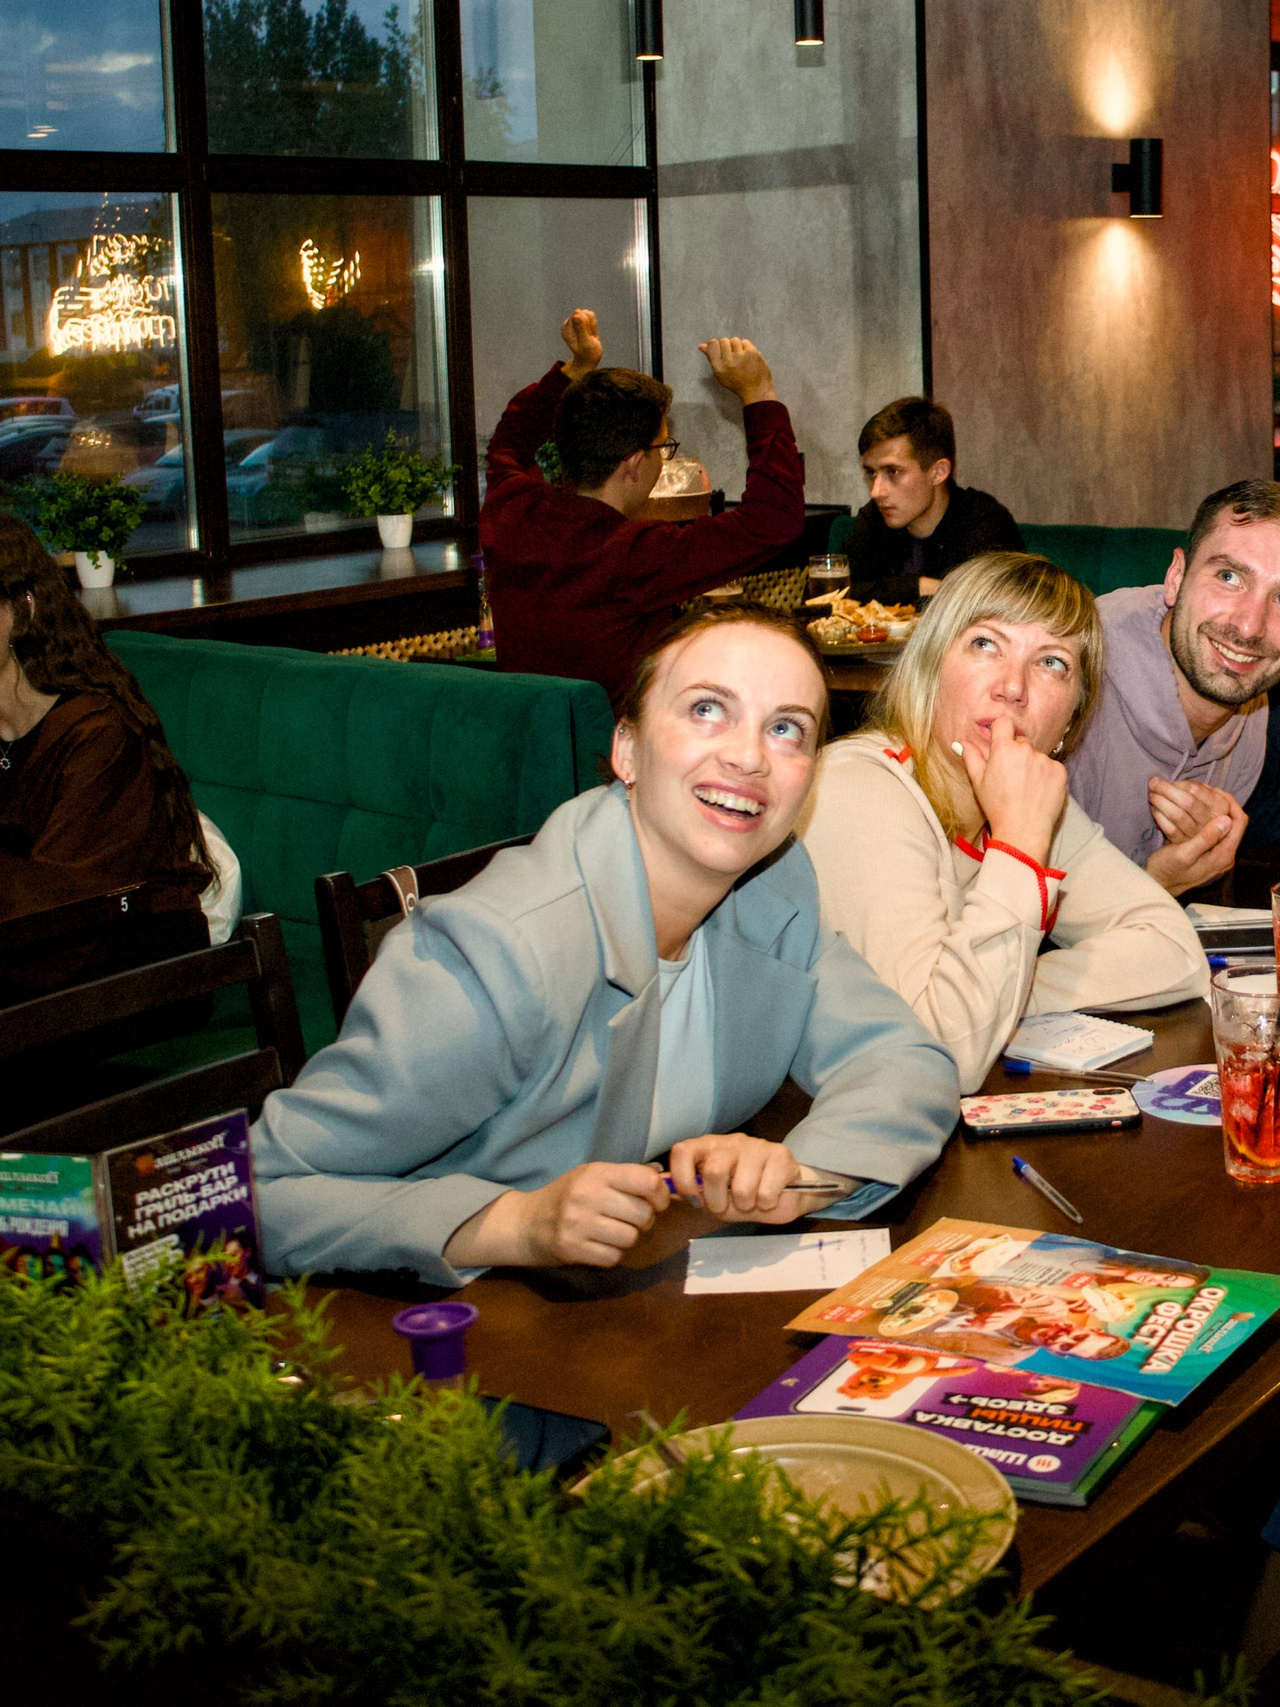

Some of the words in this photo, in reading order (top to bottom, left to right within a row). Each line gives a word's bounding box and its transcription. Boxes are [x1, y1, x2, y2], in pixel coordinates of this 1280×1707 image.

[121, 896, 129, 912] 5
[134, 1161, 236, 1206] РАСКРУТИ
[134, 1175, 240, 1221] ГРИЛЬ-БАР
[127, 1219, 157, 1239] НА
[157, 1185, 248, 1228] ПОДАРКИ
[1131, 1301, 1183, 1348] ФЕСТ
[1139, 1286, 1228, 1374] ОКРОШКА
[914, 1410, 1075, 1446] ДОСТАВКА
[969, 1396, 1068, 1415] ЗДЕСЬ
[969, 1407, 1085, 1432] ПИЦЦЫ
